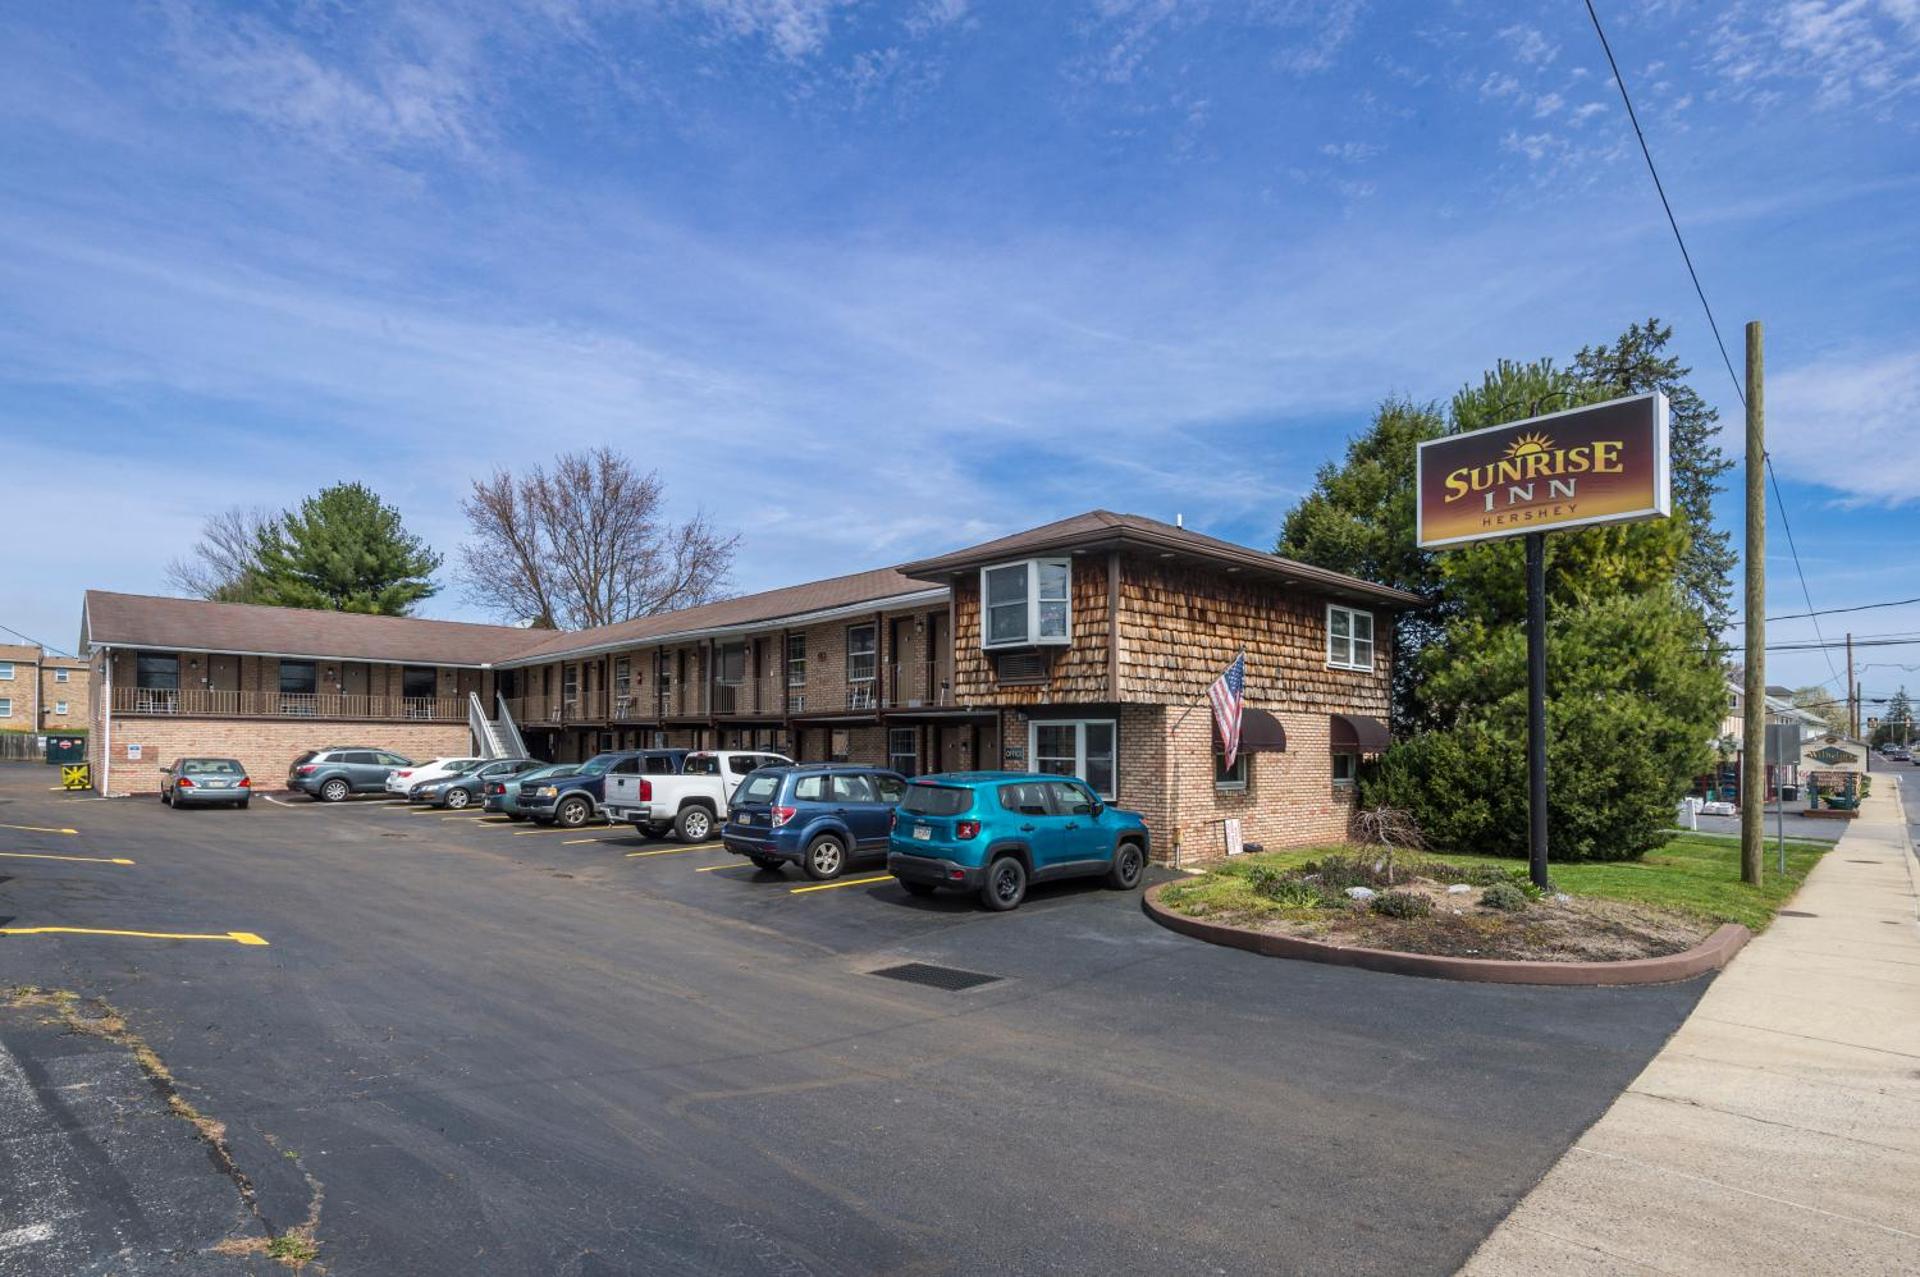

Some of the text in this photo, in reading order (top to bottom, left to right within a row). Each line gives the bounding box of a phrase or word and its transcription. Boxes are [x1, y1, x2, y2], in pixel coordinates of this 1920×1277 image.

[1444, 441, 1624, 503] SUNRISE
[1484, 478, 1577, 513] INN
[1482, 503, 1577, 527] HERSHEY
